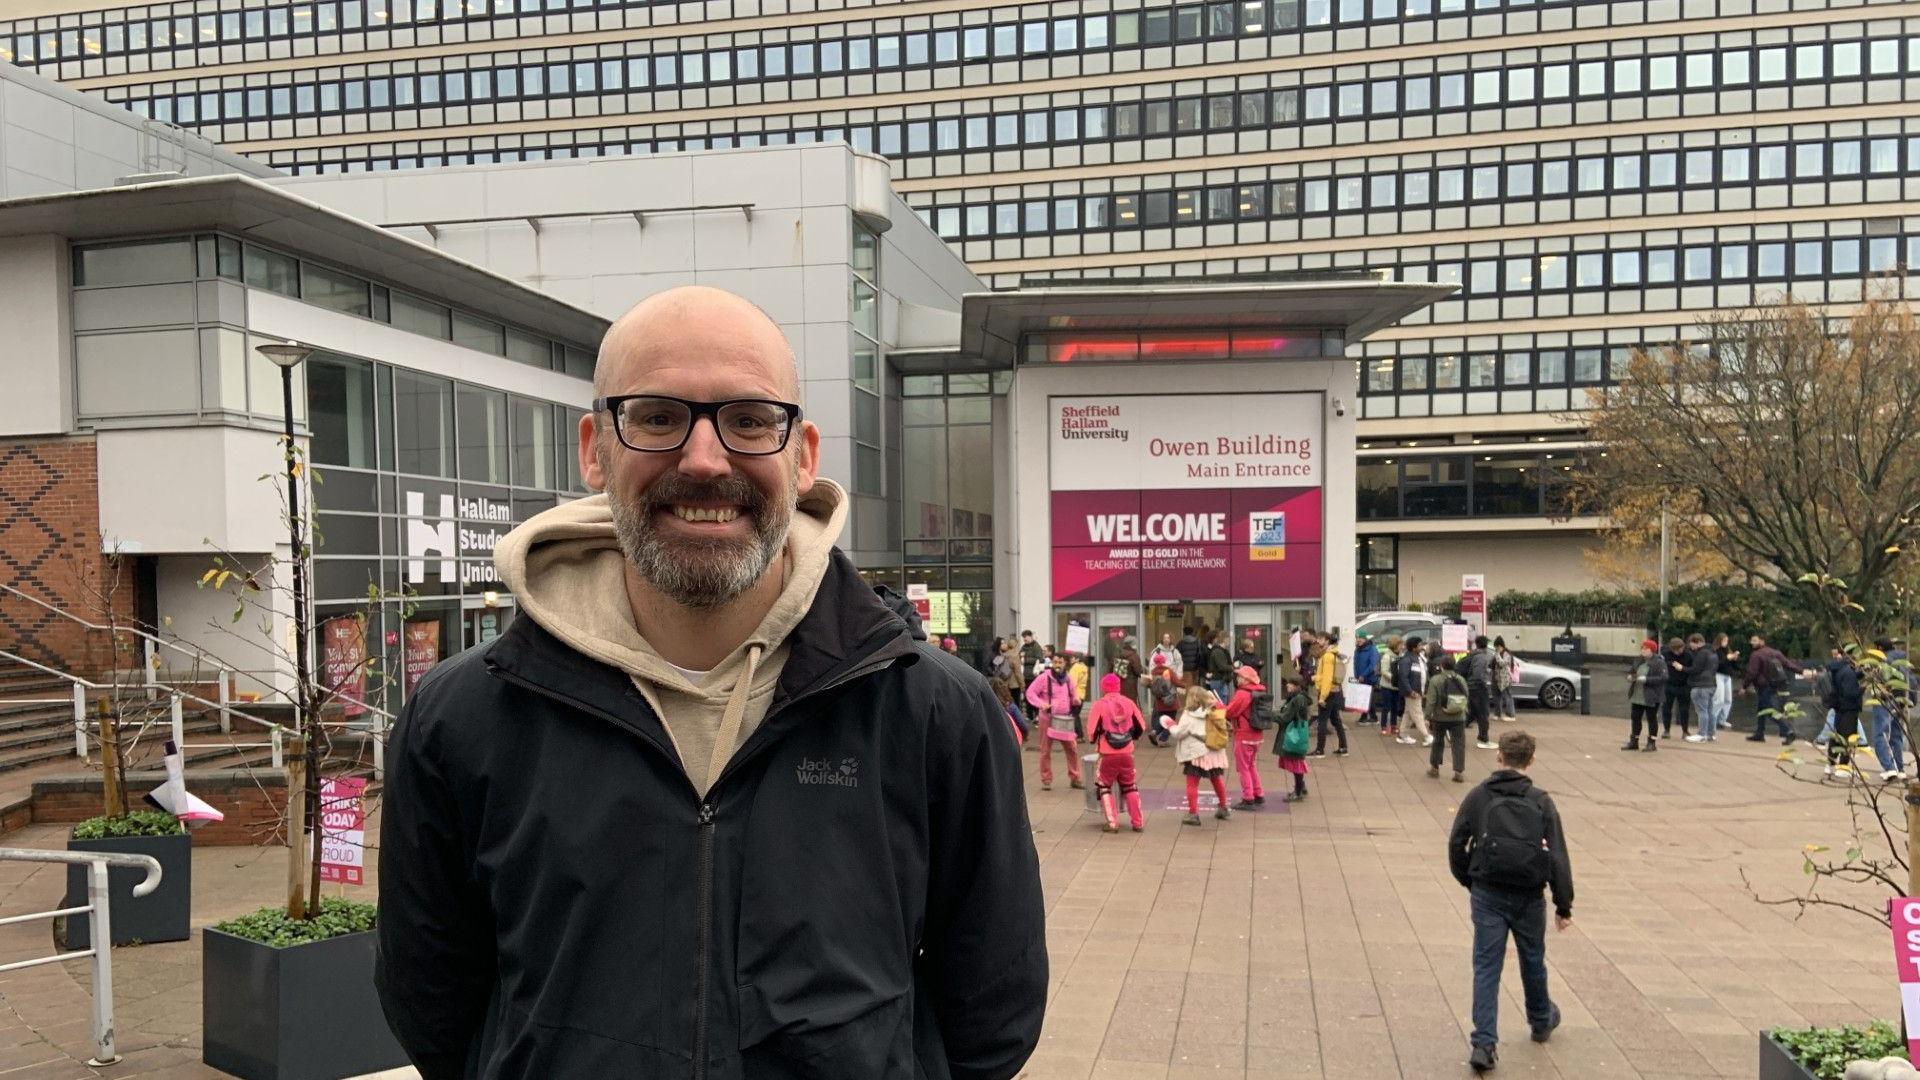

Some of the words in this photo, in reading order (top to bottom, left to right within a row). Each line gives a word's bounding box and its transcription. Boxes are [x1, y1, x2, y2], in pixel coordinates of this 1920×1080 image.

[1061, 405, 1120, 417] Sheffield
[1061, 418, 1109, 429] Hallam
[1061, 428, 1129, 442] University
[1149, 438, 1210, 457] Owen
[1216, 434, 1311, 459] Building
[1187, 462, 1230, 477] Main
[1235, 462, 1311, 477] Entrance
[459, 497, 510, 521] Hallam
[1086, 513, 1226, 543] WELCOME
[1252, 517, 1282, 531] TEF
[1254, 531, 1282, 541] 2023
[1109, 548, 1154, 558] AWARDED
[1155, 548, 1179, 558] GOLD
[1179, 548, 1187, 558] IN
[1189, 547, 1205, 558] THE
[1257, 549, 1278, 558] Gold
[1085, 560, 1123, 570] TEACHING
[1124, 559, 1176, 569] EXCELLENCE
[1177, 558, 1227, 569] FRAMEWORK
[797, 757, 832, 771] Jack
[796, 769, 858, 788] Wolfskin
[321, 812, 356, 828] ODAY
[322, 847, 355, 863] ROUD
